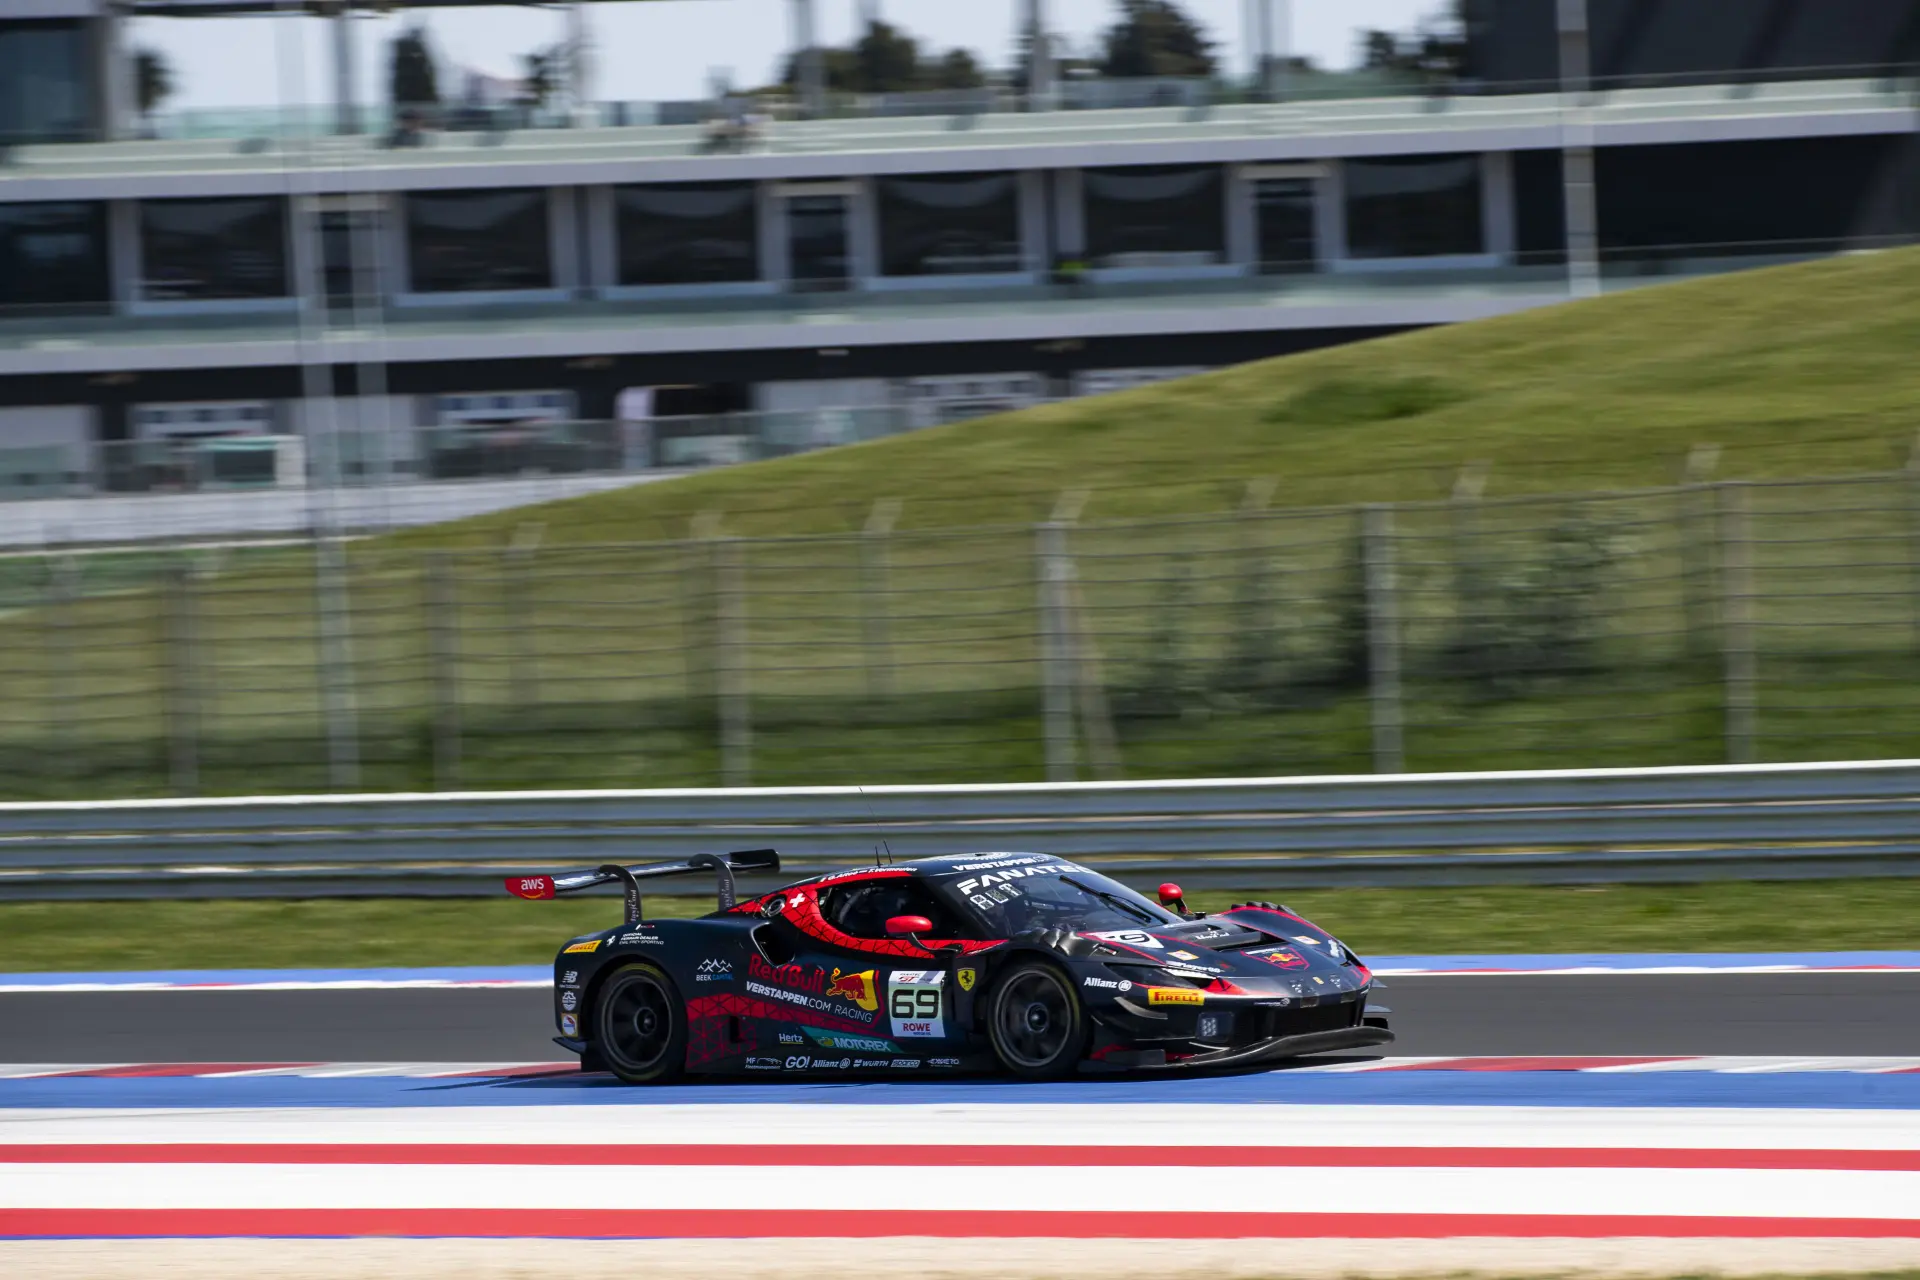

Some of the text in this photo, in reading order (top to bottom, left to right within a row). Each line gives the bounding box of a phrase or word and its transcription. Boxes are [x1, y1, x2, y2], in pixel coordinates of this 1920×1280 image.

[521, 879, 544, 890] aws
[1084, 977, 1118, 988] Allianz
[746, 981, 873, 1023] VERSTAPPEN.COM RACING
[1154, 991, 1200, 1002] PIRELLI
[892, 989, 939, 1019] 69
[903, 1023, 931, 1031] ROWE
[779, 1033, 803, 1042] Hertz
[834, 1037, 891, 1052] MOTOREX
[785, 1056, 811, 1068] GO!
[811, 1059, 839, 1068] Allianz
